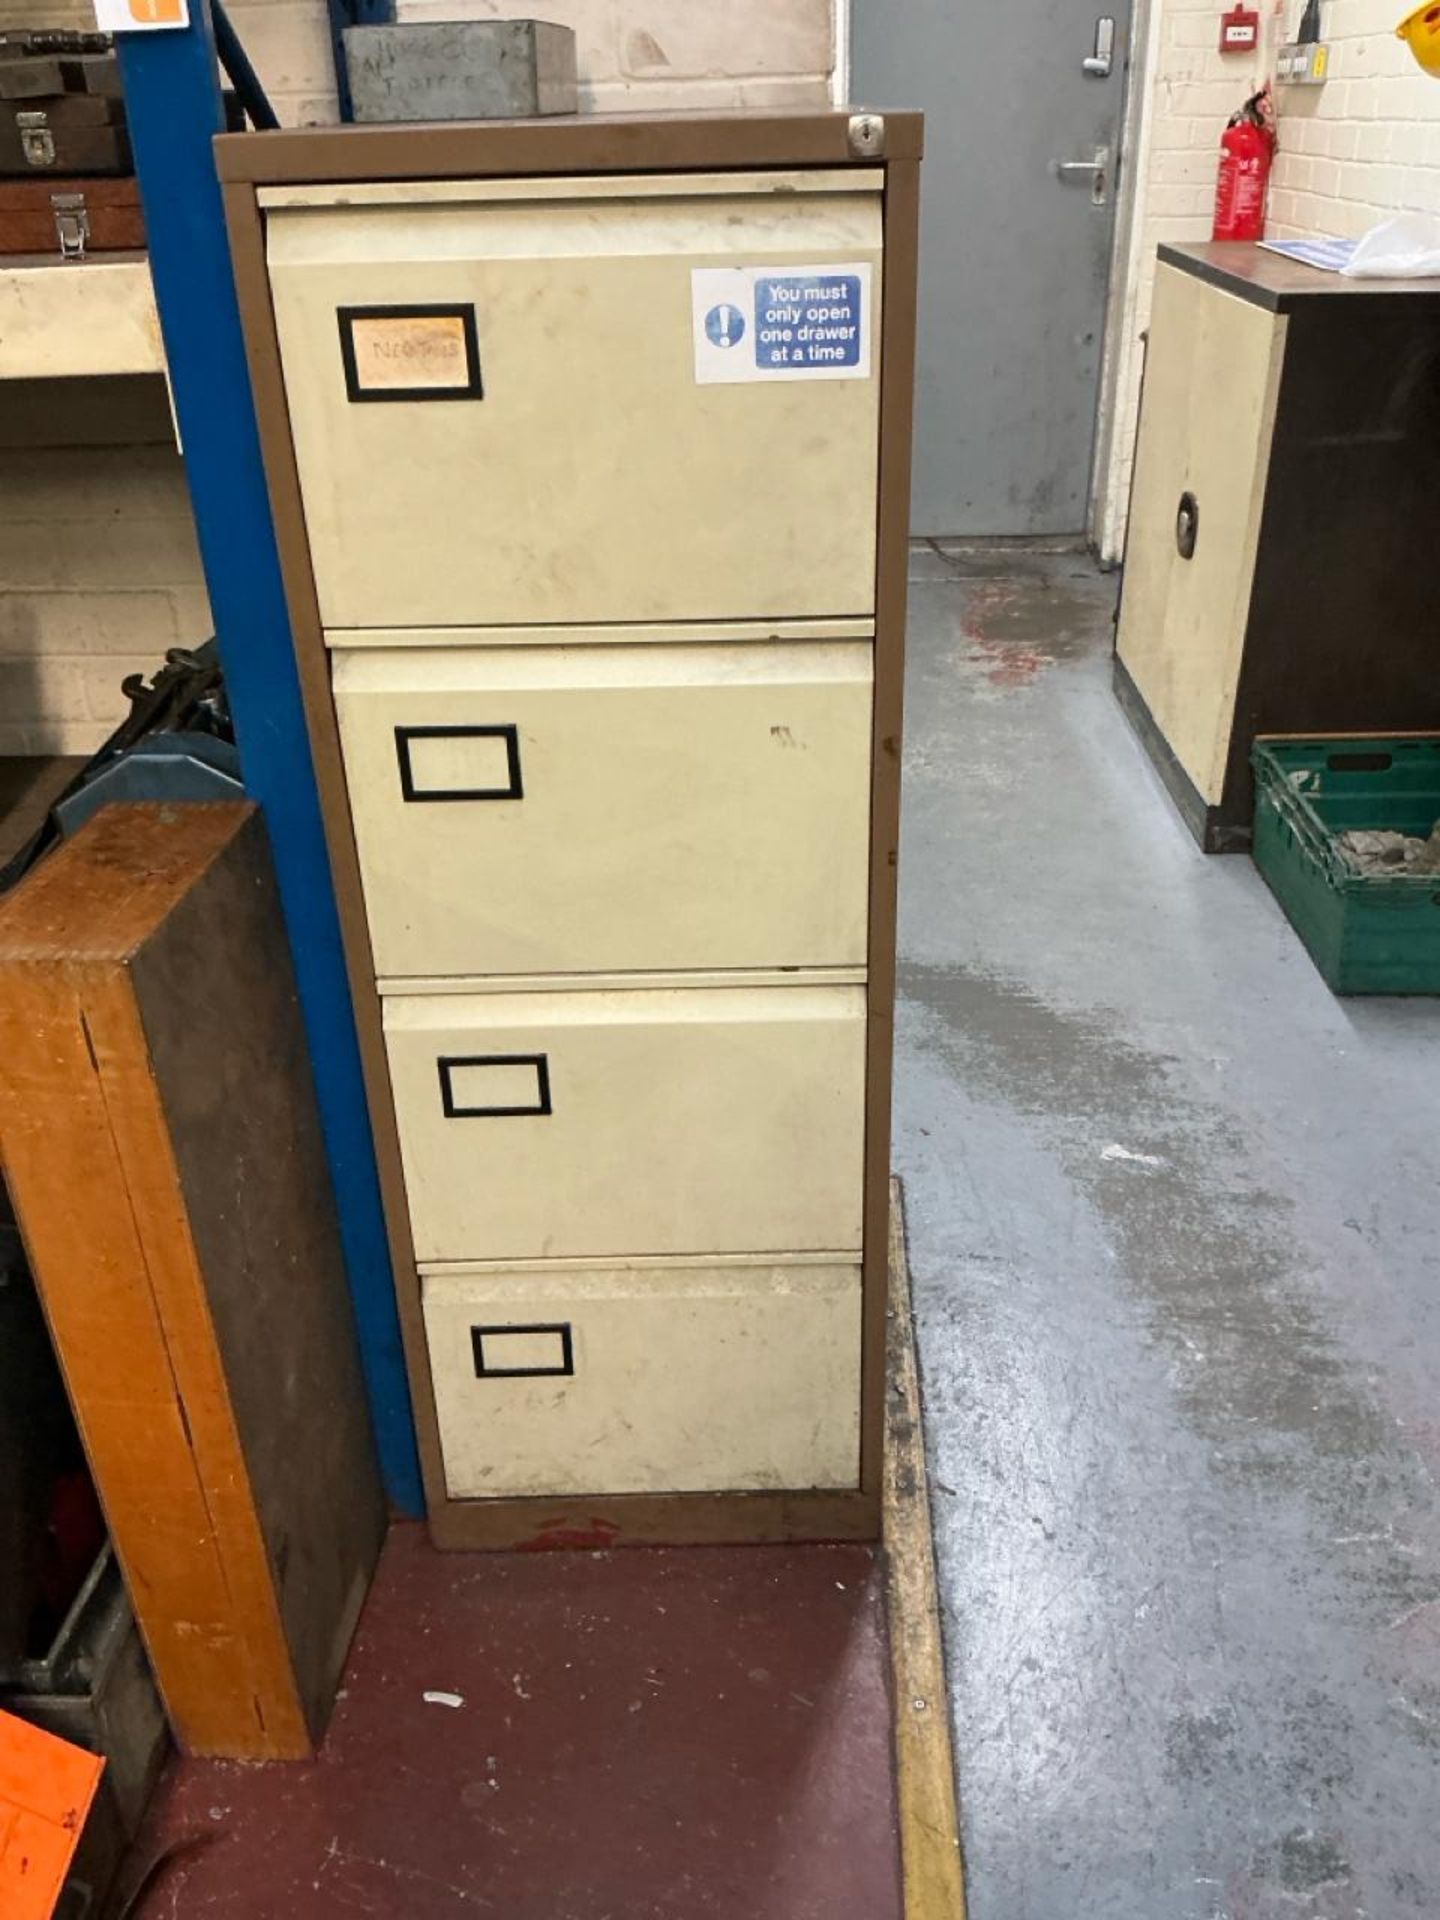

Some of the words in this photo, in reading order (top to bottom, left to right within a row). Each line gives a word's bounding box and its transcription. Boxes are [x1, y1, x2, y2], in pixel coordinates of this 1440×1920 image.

[769, 285, 800, 302] You
[804, 284, 848, 301] must
[765, 306, 802, 324] only
[806, 306, 850, 323] open
[760, 329, 792, 343] one
[797, 326, 856, 341] drawer
[770, 347, 788, 362] at
[792, 350, 803, 361] a
[808, 346, 845, 360] time
